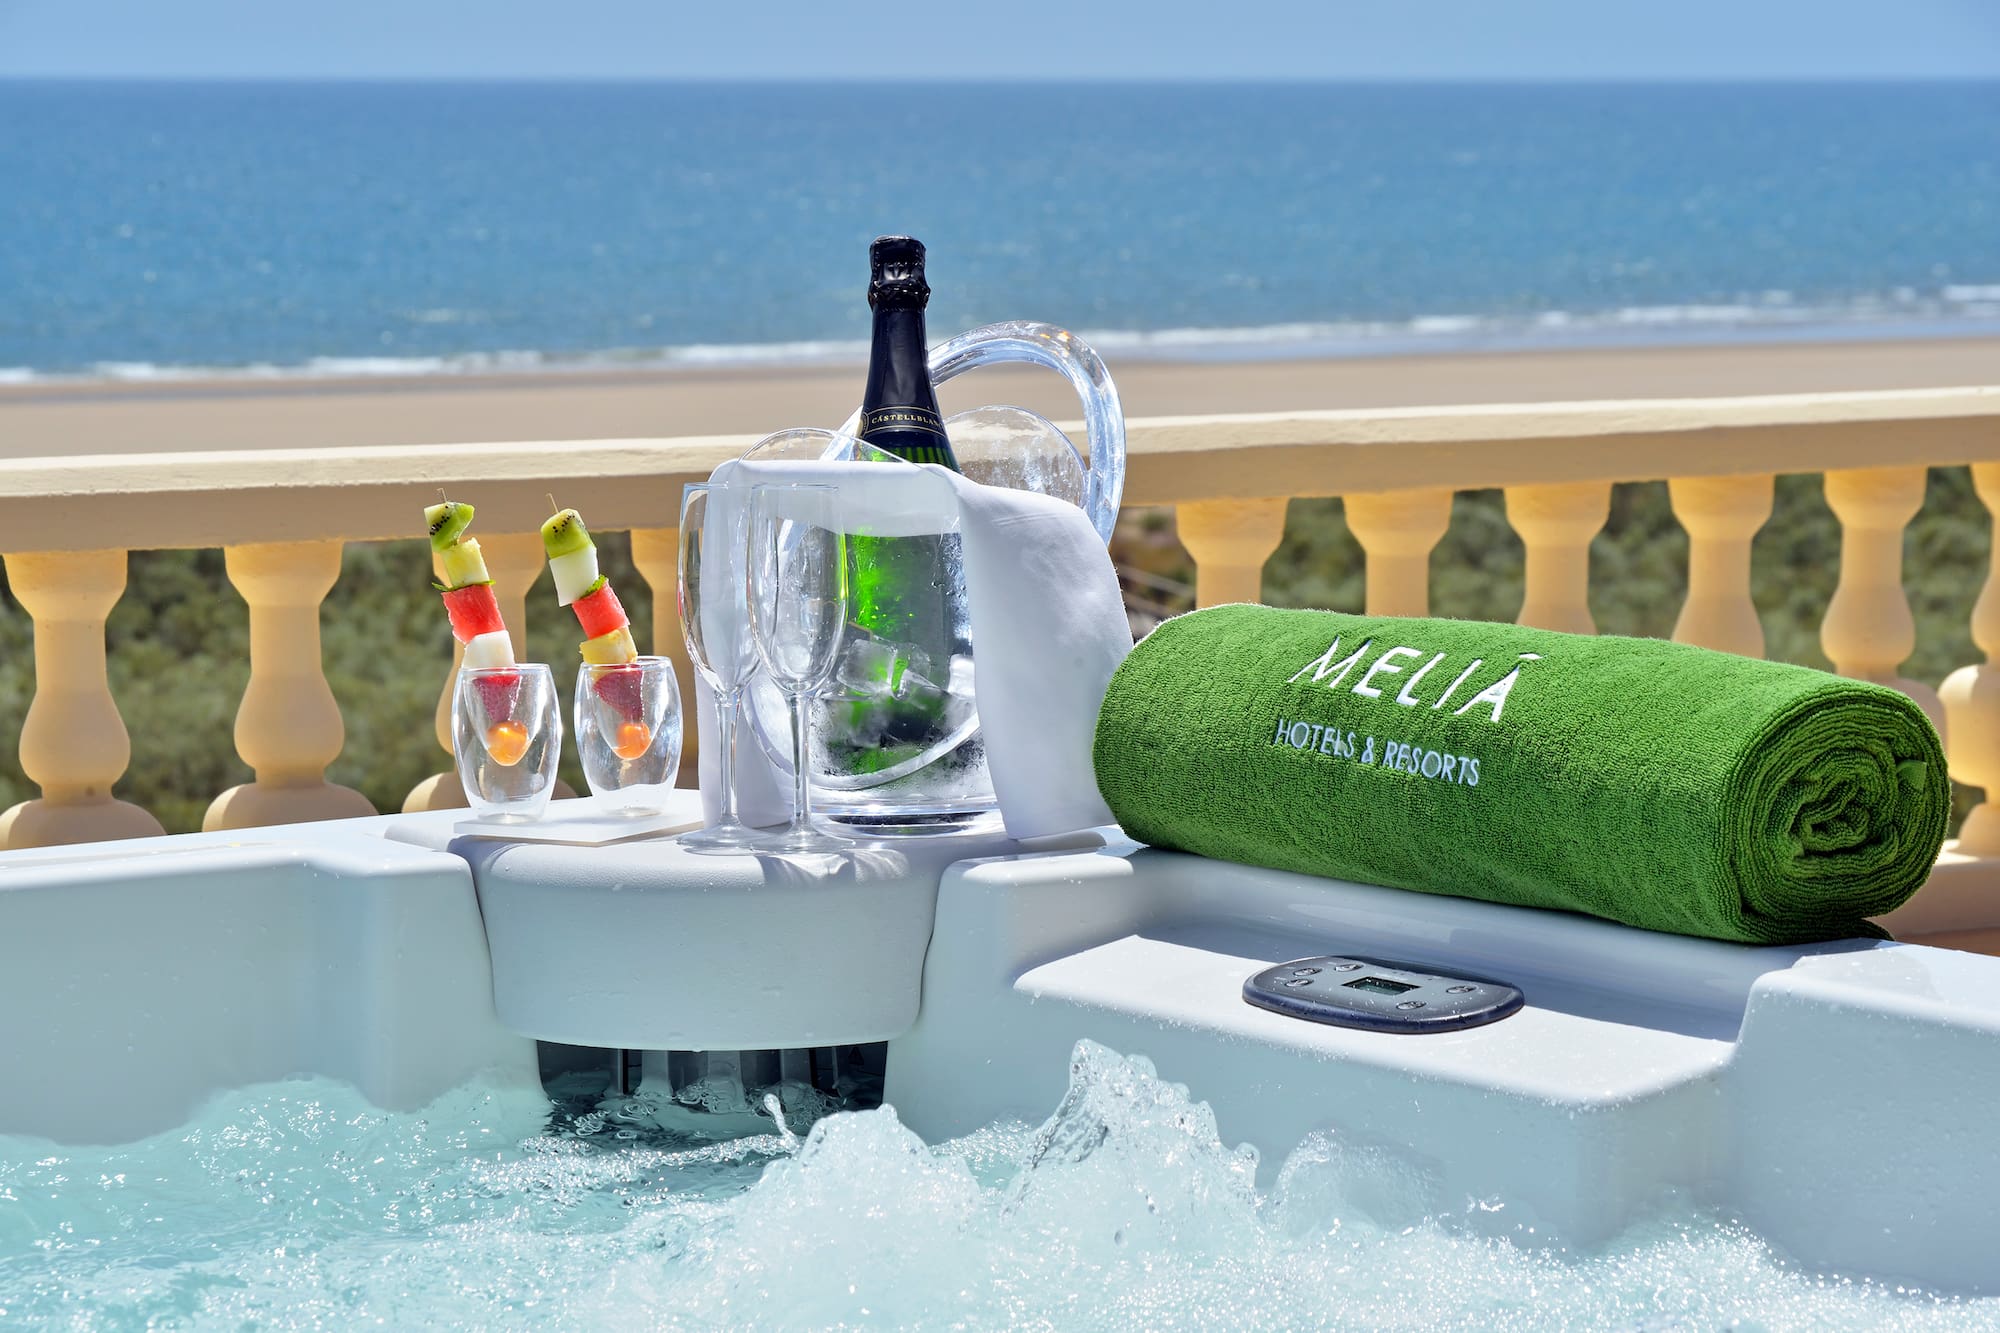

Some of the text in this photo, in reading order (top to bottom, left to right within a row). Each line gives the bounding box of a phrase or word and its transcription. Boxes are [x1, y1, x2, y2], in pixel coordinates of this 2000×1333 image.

[871, 414, 942, 427] CASTELLBLAN
[1287, 636, 1548, 722] MELIÁ
[1275, 718, 1480, 787] HOTELS & RESORTS
